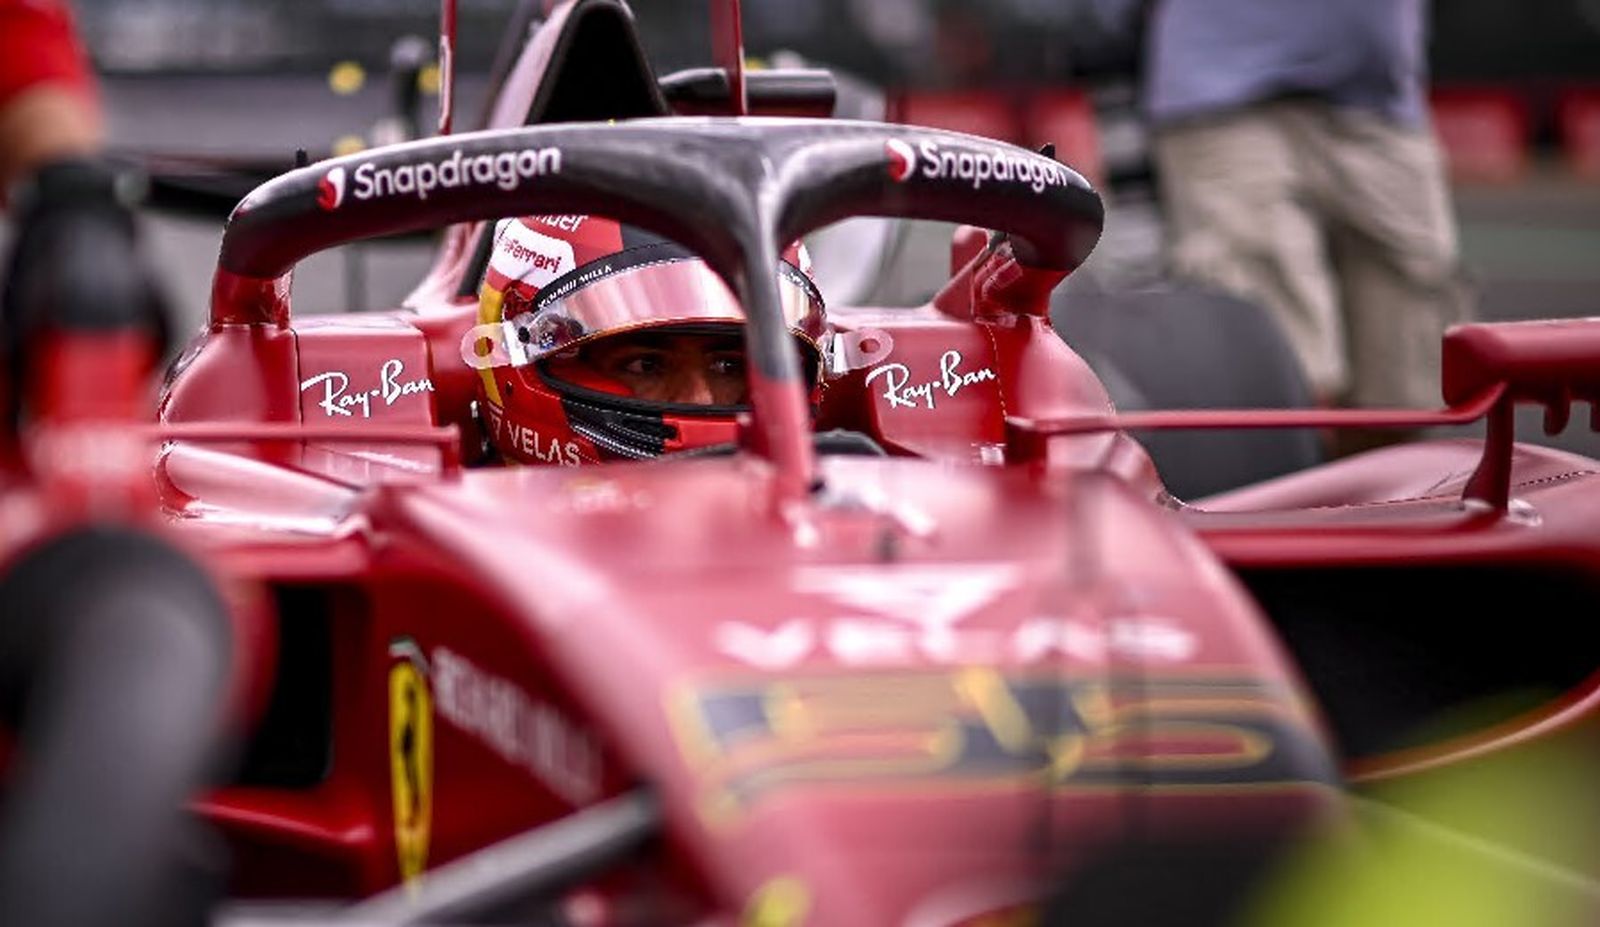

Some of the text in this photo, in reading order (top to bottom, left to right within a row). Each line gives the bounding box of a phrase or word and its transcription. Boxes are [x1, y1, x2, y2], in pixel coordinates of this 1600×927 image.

[353, 147, 562, 200] Snapdragon
[919, 140, 1067, 193] Snapdragon
[300, 358, 436, 418] Ray-Ban
[865, 350, 996, 409] Ray-Ban
[506, 419, 581, 467] VELAS
